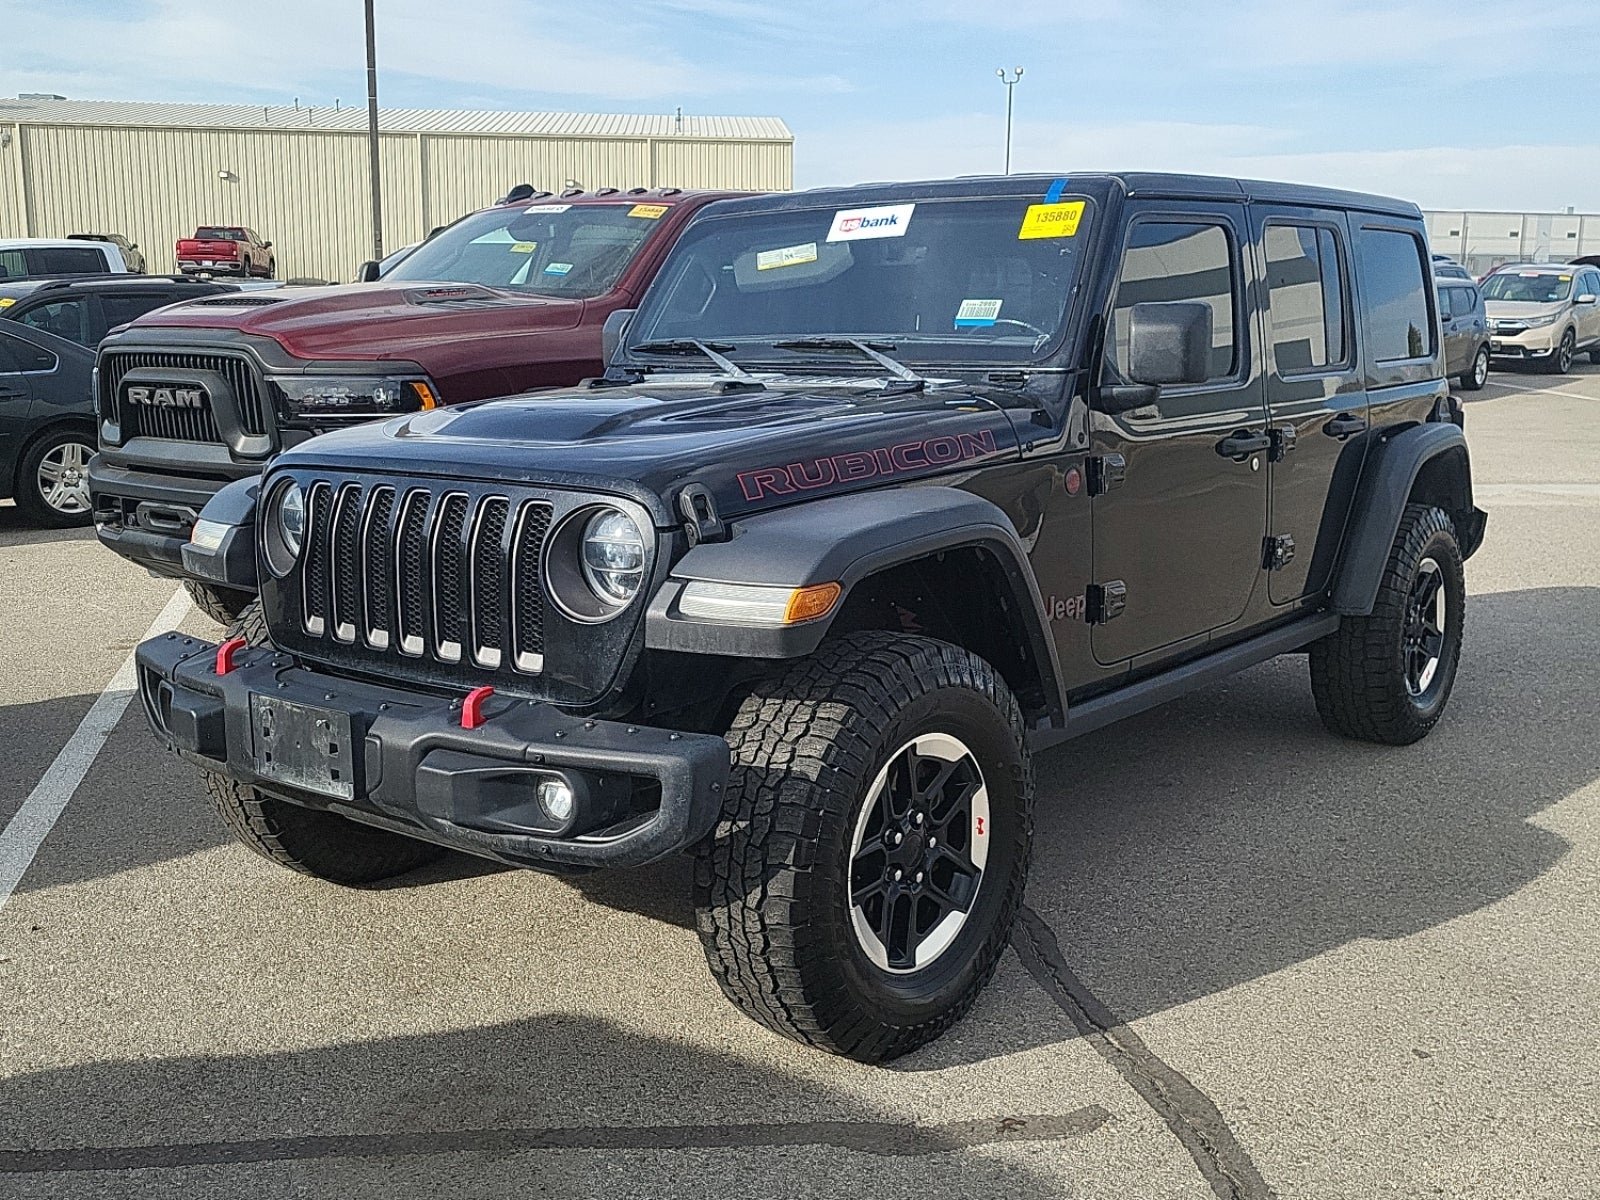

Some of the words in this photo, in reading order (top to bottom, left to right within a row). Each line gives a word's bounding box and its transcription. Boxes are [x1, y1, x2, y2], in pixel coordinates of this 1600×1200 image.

[1036, 210, 1077, 223] 135880
[128, 386, 205, 408] RAM
[737, 430, 997, 500] RUBICON
[1048, 595, 1086, 622] Jeep
